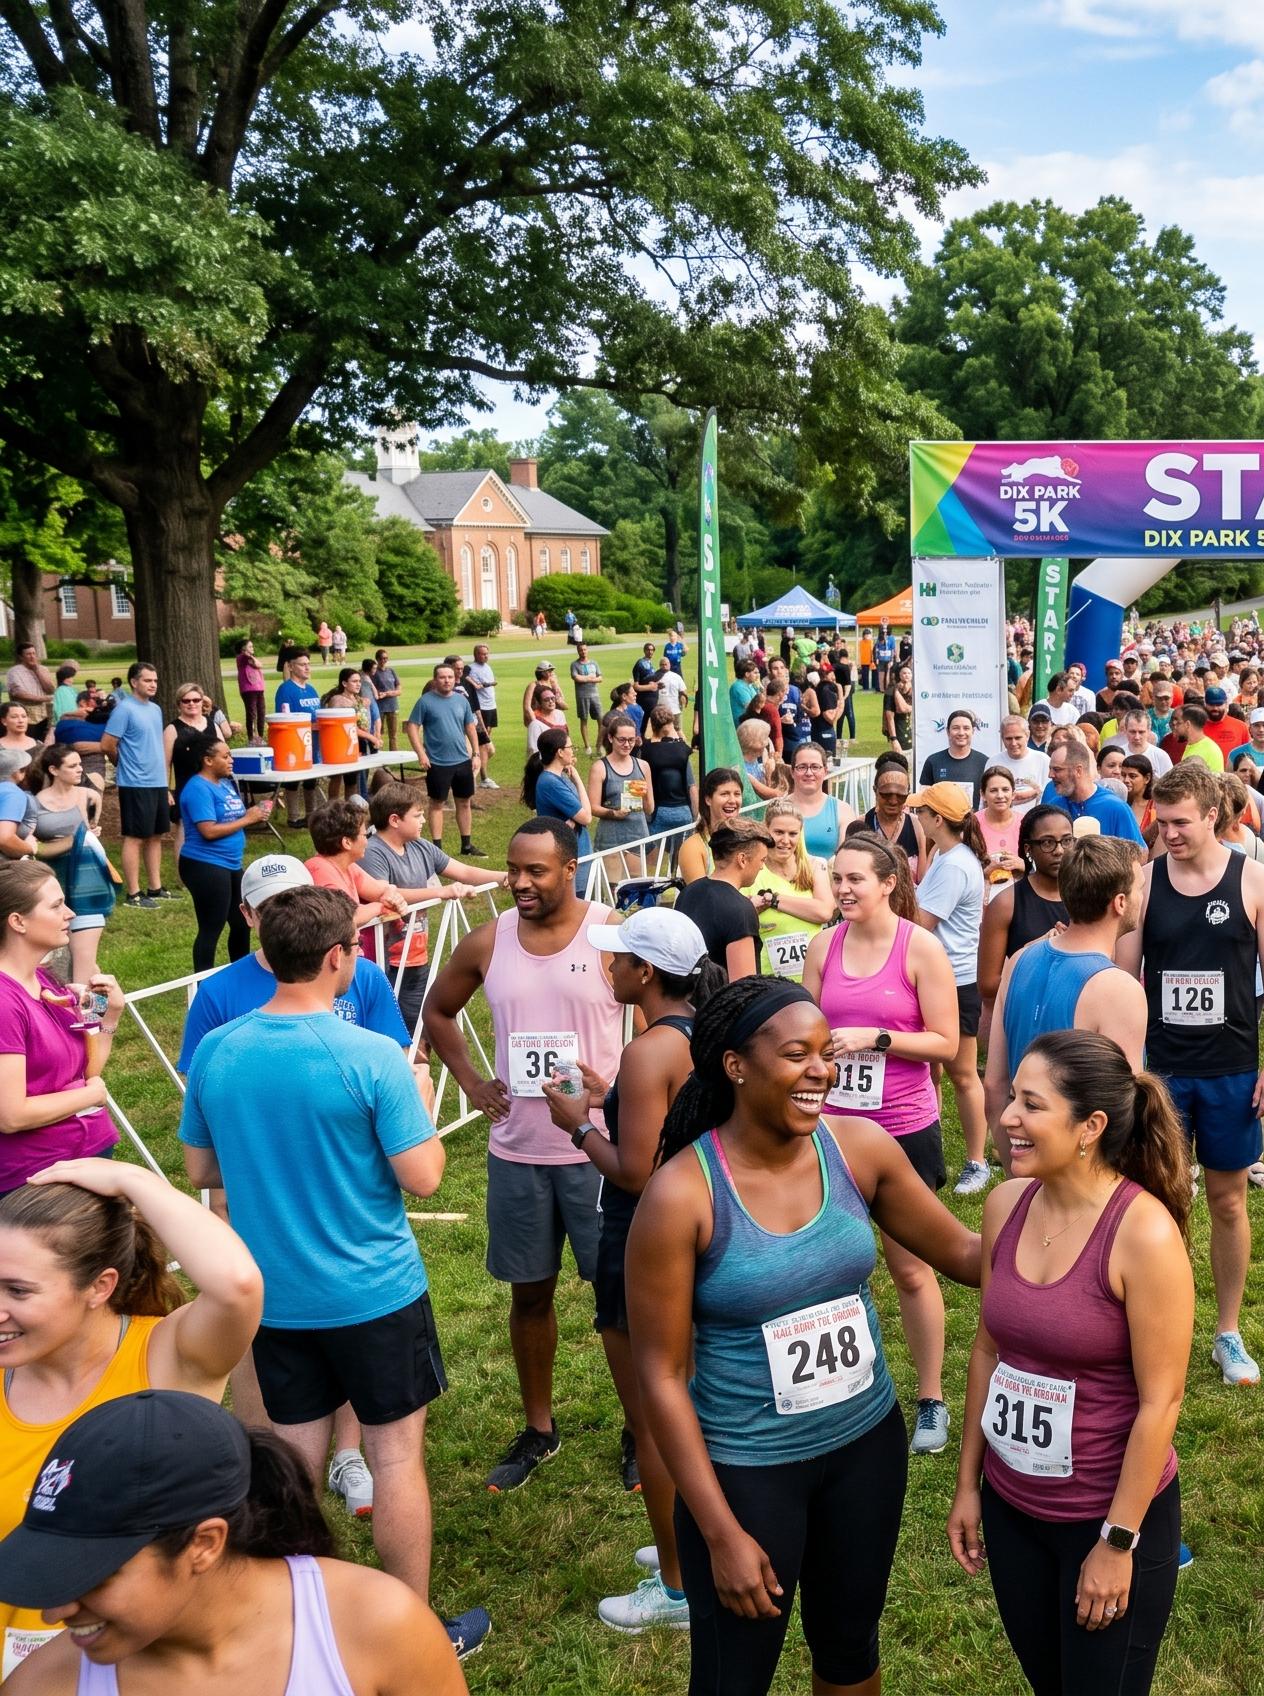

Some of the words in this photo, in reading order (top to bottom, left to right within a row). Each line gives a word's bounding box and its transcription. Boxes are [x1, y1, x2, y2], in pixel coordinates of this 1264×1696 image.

[1000, 486, 1029, 499] DIX
[1034, 486, 1081, 499] PARK
[1013, 501, 1070, 533] 5K
[1144, 530, 1183, 547] DIX
[1190, 530, 1250, 547] PARK
[1172, 987, 1213, 1012] 126
[787, 1325, 860, 1385] 248
[992, 1393, 1053, 1449] 315
